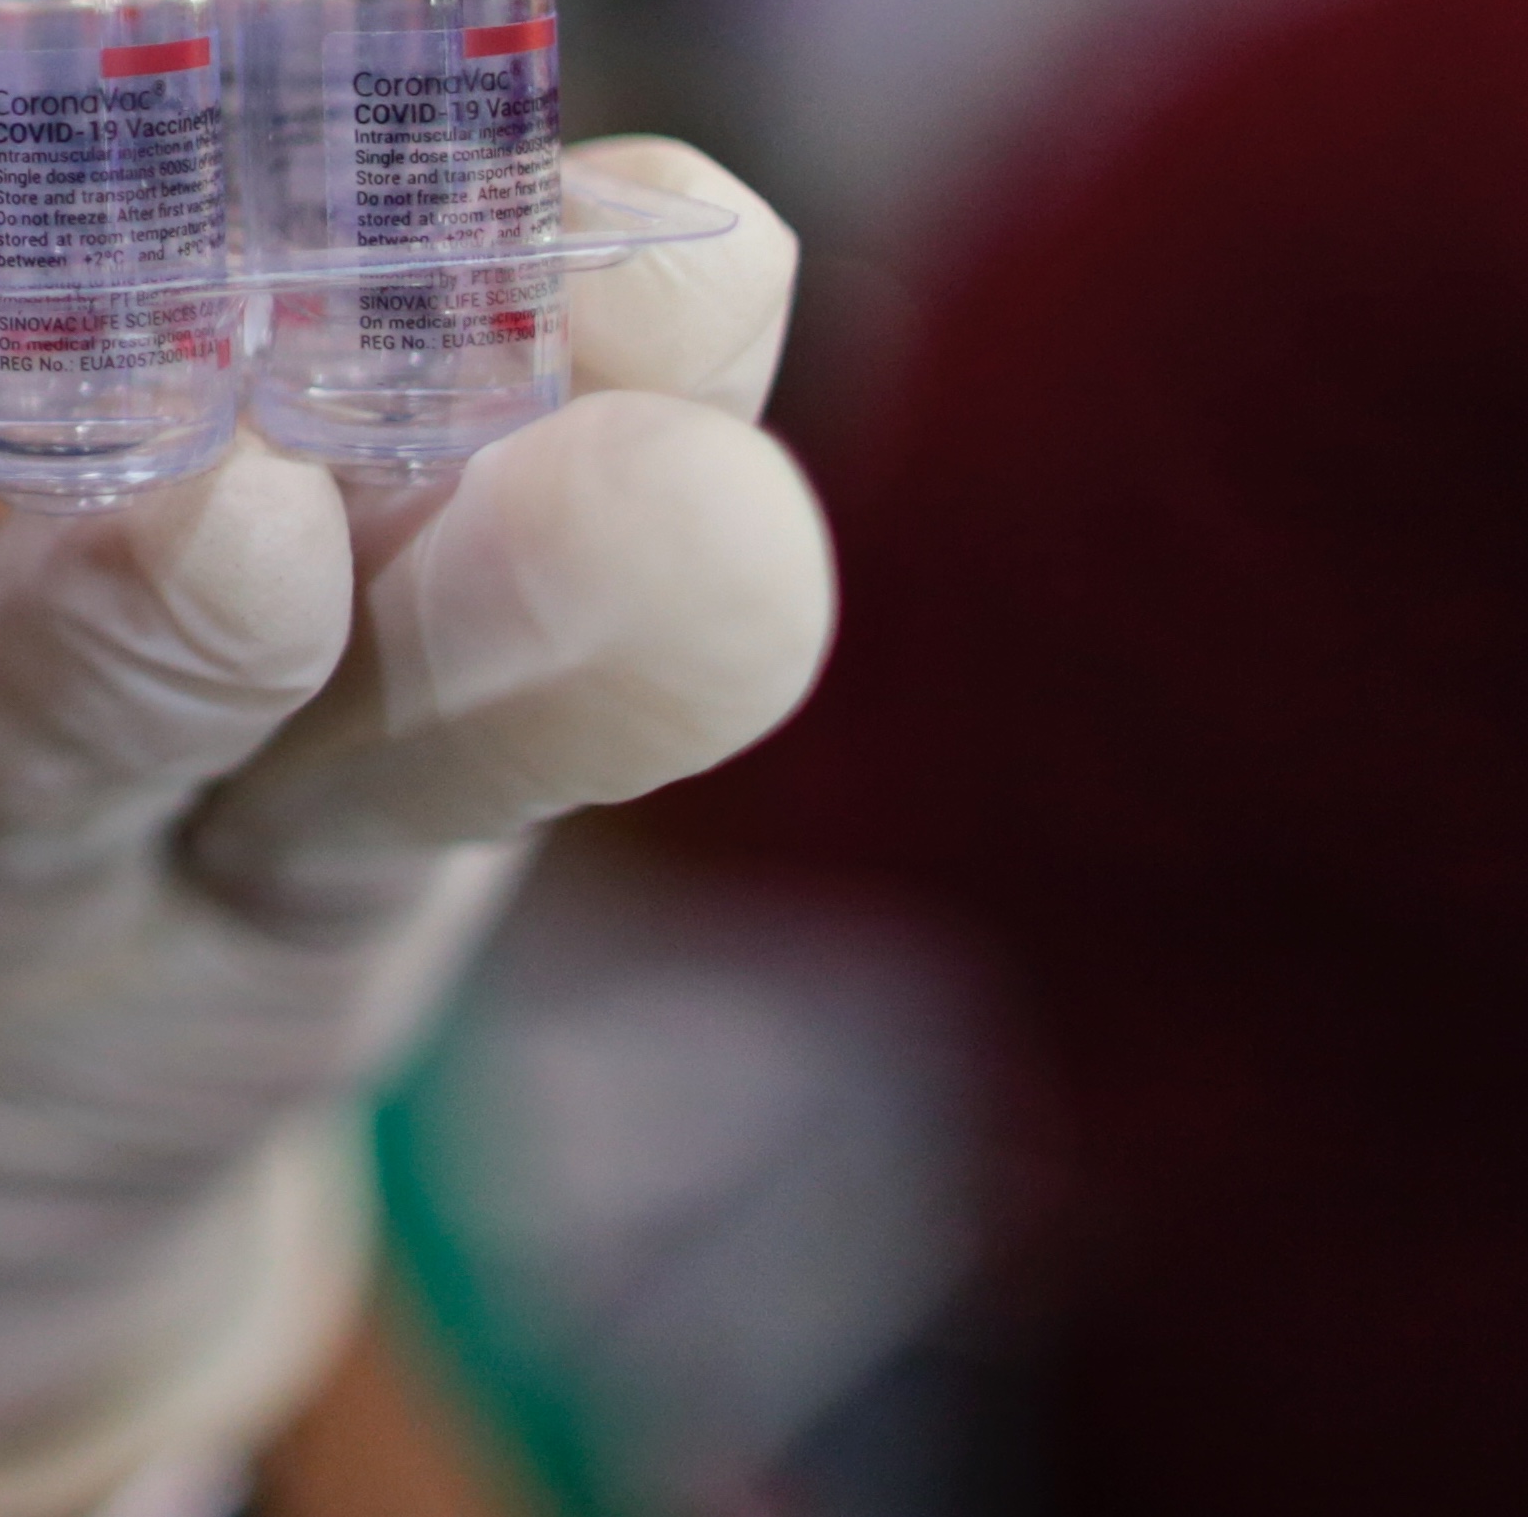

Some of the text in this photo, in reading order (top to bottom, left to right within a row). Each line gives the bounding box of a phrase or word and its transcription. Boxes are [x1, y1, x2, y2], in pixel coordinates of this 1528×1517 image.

[354, 100, 479, 125] COVID-19
[125, 111, 201, 139] Vaccine
[355, 127, 472, 144] Intramuscular
[117, 141, 181, 163] injection
[355, 145, 512, 168] Single dose contains
[46, 168, 86, 184] dose
[90, 165, 155, 183] contains
[356, 165, 513, 185] Store and transport
[44, 189, 76, 204] and
[82, 184, 157, 205] transport
[357, 190, 379, 206] Do
[383, 192, 412, 206] not
[477, 186, 511, 201] After
[21, 211, 49, 226] not
[116, 206, 154, 223] After
[157, 203, 184, 219] first
[357, 210, 410, 226] stored
[418, 212, 434, 225] at
[442, 211, 484, 226] room
[56, 232, 73, 247] at
[79, 232, 123, 246] room
[357, 231, 431, 246] between
[497, 225, 521, 239] and
[138, 243, 165, 262] and
[359, 295, 439, 311] SINOVAC
[445, 292, 480, 309] LIFE
[486, 281, 547, 306] SCIENCES
[82, 314, 120, 332] LIFE
[125, 305, 197, 329] SCIENCES
[360, 315, 382, 330] On
[389, 315, 456, 329] medical
[26, 336, 95, 352] medical
[101, 329, 192, 354] prescription
[361, 336, 395, 350] REG
[0, 355, 33, 372] REG
